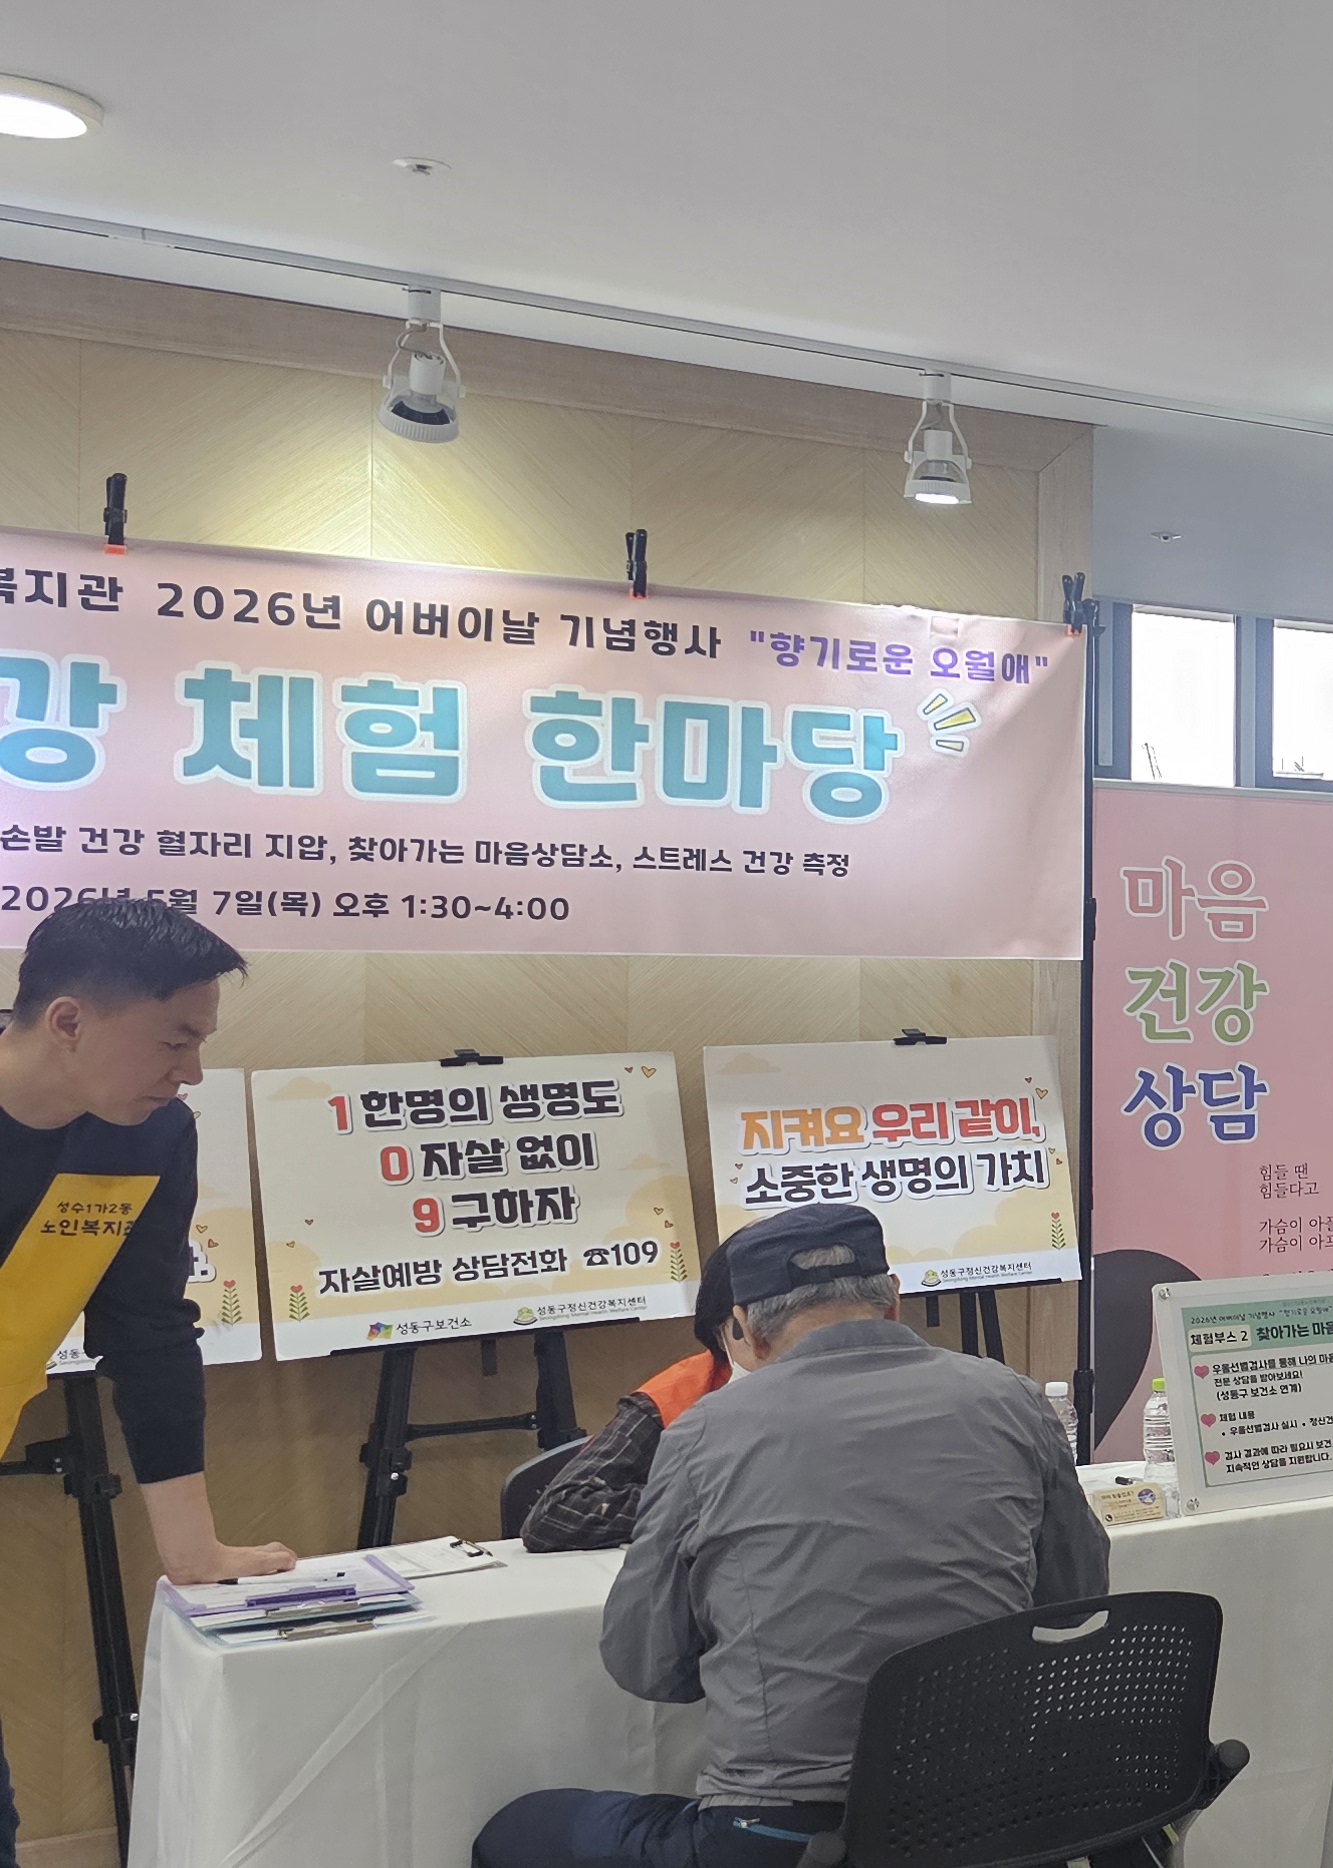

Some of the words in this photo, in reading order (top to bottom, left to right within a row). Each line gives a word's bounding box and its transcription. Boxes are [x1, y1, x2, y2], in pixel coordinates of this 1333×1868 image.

[156, 581, 342, 631] 2026년
[365, 597, 540, 646] 어버이날
[559, 613, 722, 660] 기념행사
[749, 629, 915, 676] "향기로운
[929, 645, 1050, 685] 오월애"
[0, 652, 123, 787] 강
[180, 665, 463, 800] 체험
[527, 687, 900, 821] 한마당
[1, 823, 67, 852] 손발
[78, 826, 144, 856] 건강
[157, 828, 252, 859] 혈자리
[265, 832, 337, 865] 지압,
[348, 835, 465, 865] 찾아가는
[475, 838, 622, 873] 마음상담소,
[632, 846, 733, 873] 스트레스
[743, 849, 794, 876] 건강
[802, 851, 850, 877] 측정
[213, 890, 322, 918] 7일(목)
[333, 892, 390, 920] 오후
[401, 893, 570, 921] 1:30~4:00
[1122, 857, 1267, 942] 마음
[1124, 959, 1269, 1045] 건강
[328, 1095, 349, 1131] 1
[360, 1086, 489, 1128] 한명의
[499, 1079, 620, 1120] 생명도
[741, 1105, 864, 1150] 지켜요
[873, 1101, 949, 1142] 우리
[955, 1097, 1040, 1138] 같이,
[1121, 1062, 1269, 1150] 상담
[380, 1145, 409, 1182] 0
[421, 1137, 508, 1177] 자살
[516, 1132, 595, 1171] 없이
[1259, 1164, 1288, 1182] 힘들
[1294, 1162, 1309, 1180] 땐
[746, 1161, 854, 1205] 소중한
[862, 1154, 969, 1197] 생명의
[976, 1150, 1045, 1187] 가치
[1259, 1182, 1319, 1200] 힘들다고
[56, 1201, 133, 1215] 성수1가2동
[413, 1197, 440, 1233] 9
[451, 1185, 577, 1229] 구하자
[1259, 1216, 1302, 1236] 가슴이
[1259, 1235, 1302, 1254] 가슴이
[318, 1259, 441, 1295] 자살예방
[452, 1247, 568, 1282] 상담전화
[537, 1296, 647, 1316] 성동구정신건강복지센터
[396, 1318, 472, 1336] 성동구보건소
[1190, 1331, 1237, 1345] 체험부스
[1240, 1330, 1248, 1342] 2
[1256, 1323, 1310, 1341] 찾아가는
[1299, 1355, 1317, 1366] 나의
[1250, 1386, 1278, 1398] 보건소
